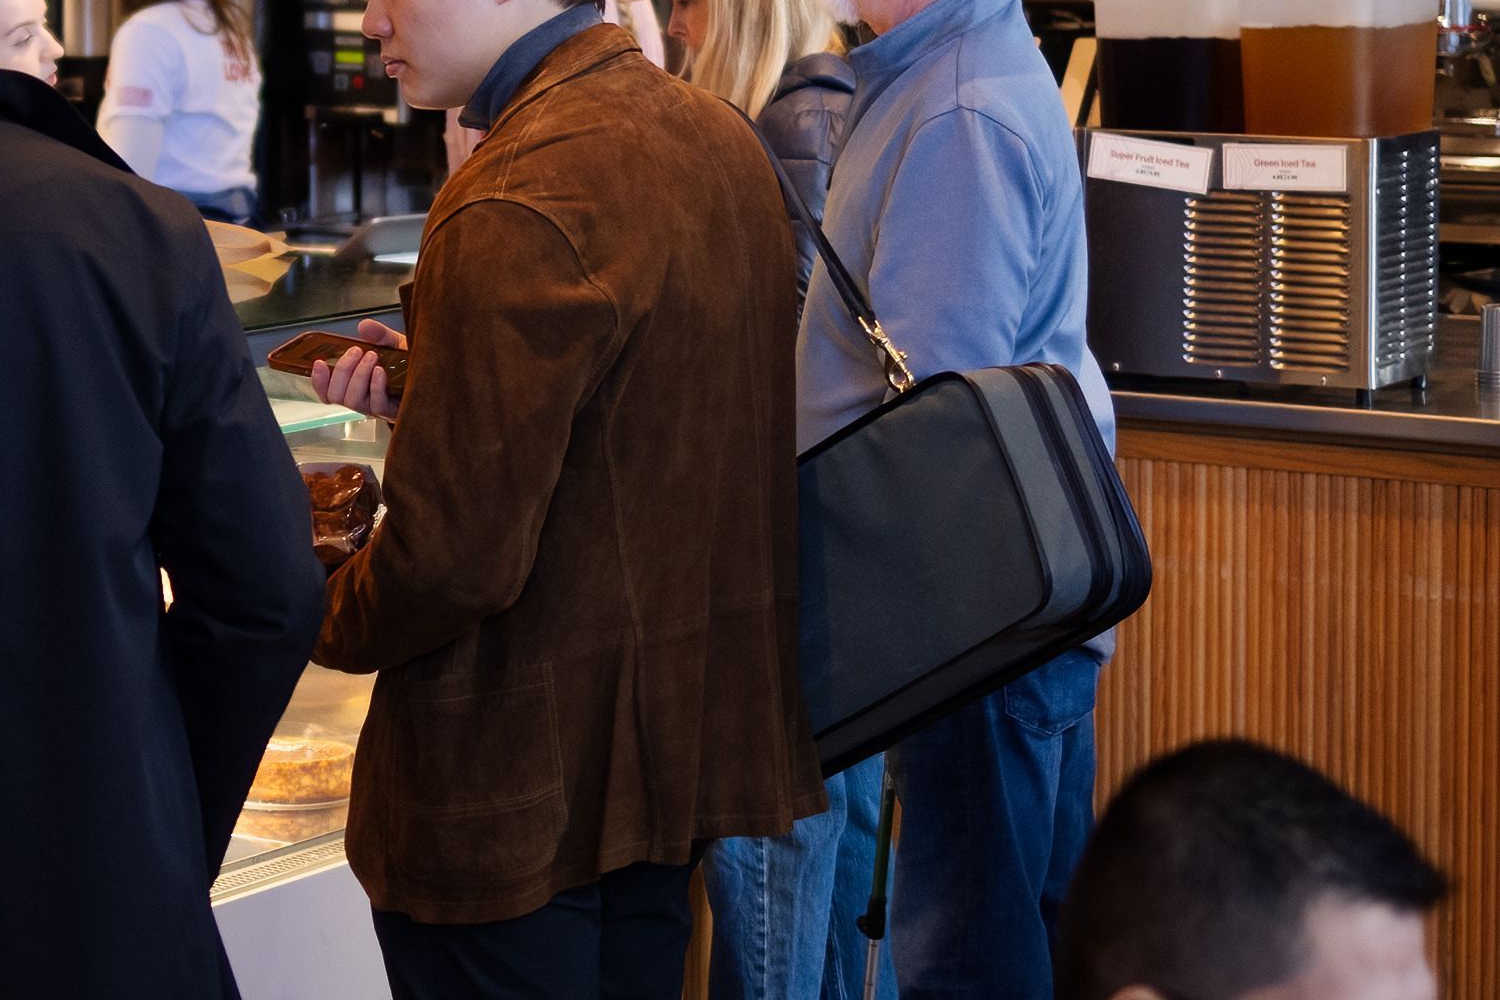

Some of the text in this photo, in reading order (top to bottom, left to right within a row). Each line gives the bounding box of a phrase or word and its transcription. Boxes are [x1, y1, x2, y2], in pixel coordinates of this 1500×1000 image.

[1110, 150, 1190, 169] Super Fruit Iced Tea
[1254, 159, 1316, 168] Green Iced Tea
